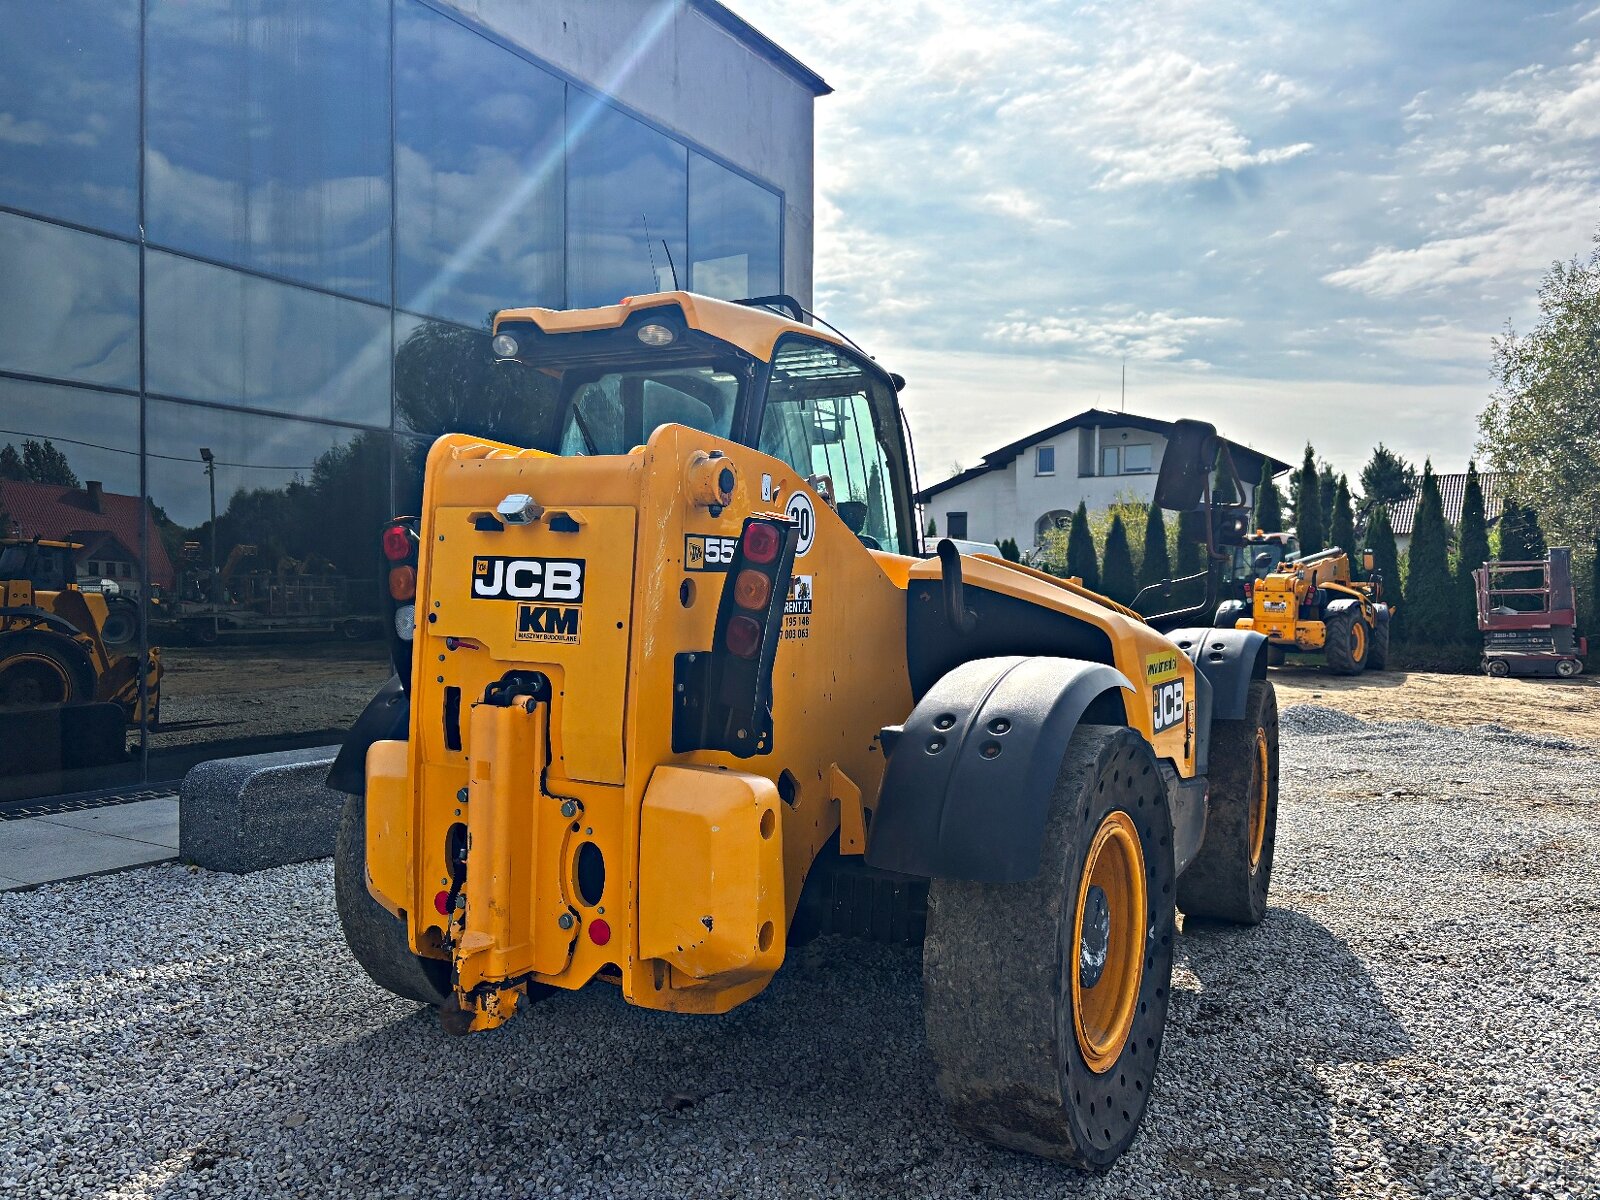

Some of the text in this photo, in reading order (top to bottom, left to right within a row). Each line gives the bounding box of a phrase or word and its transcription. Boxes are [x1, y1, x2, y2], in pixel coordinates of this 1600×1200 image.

[705, 538, 739, 564] 55
[475, 560, 581, 599] JCB
[519, 606, 579, 634] KM
[784, 601, 811, 613] RENT.PL
[1154, 682, 1184, 729] JCB
